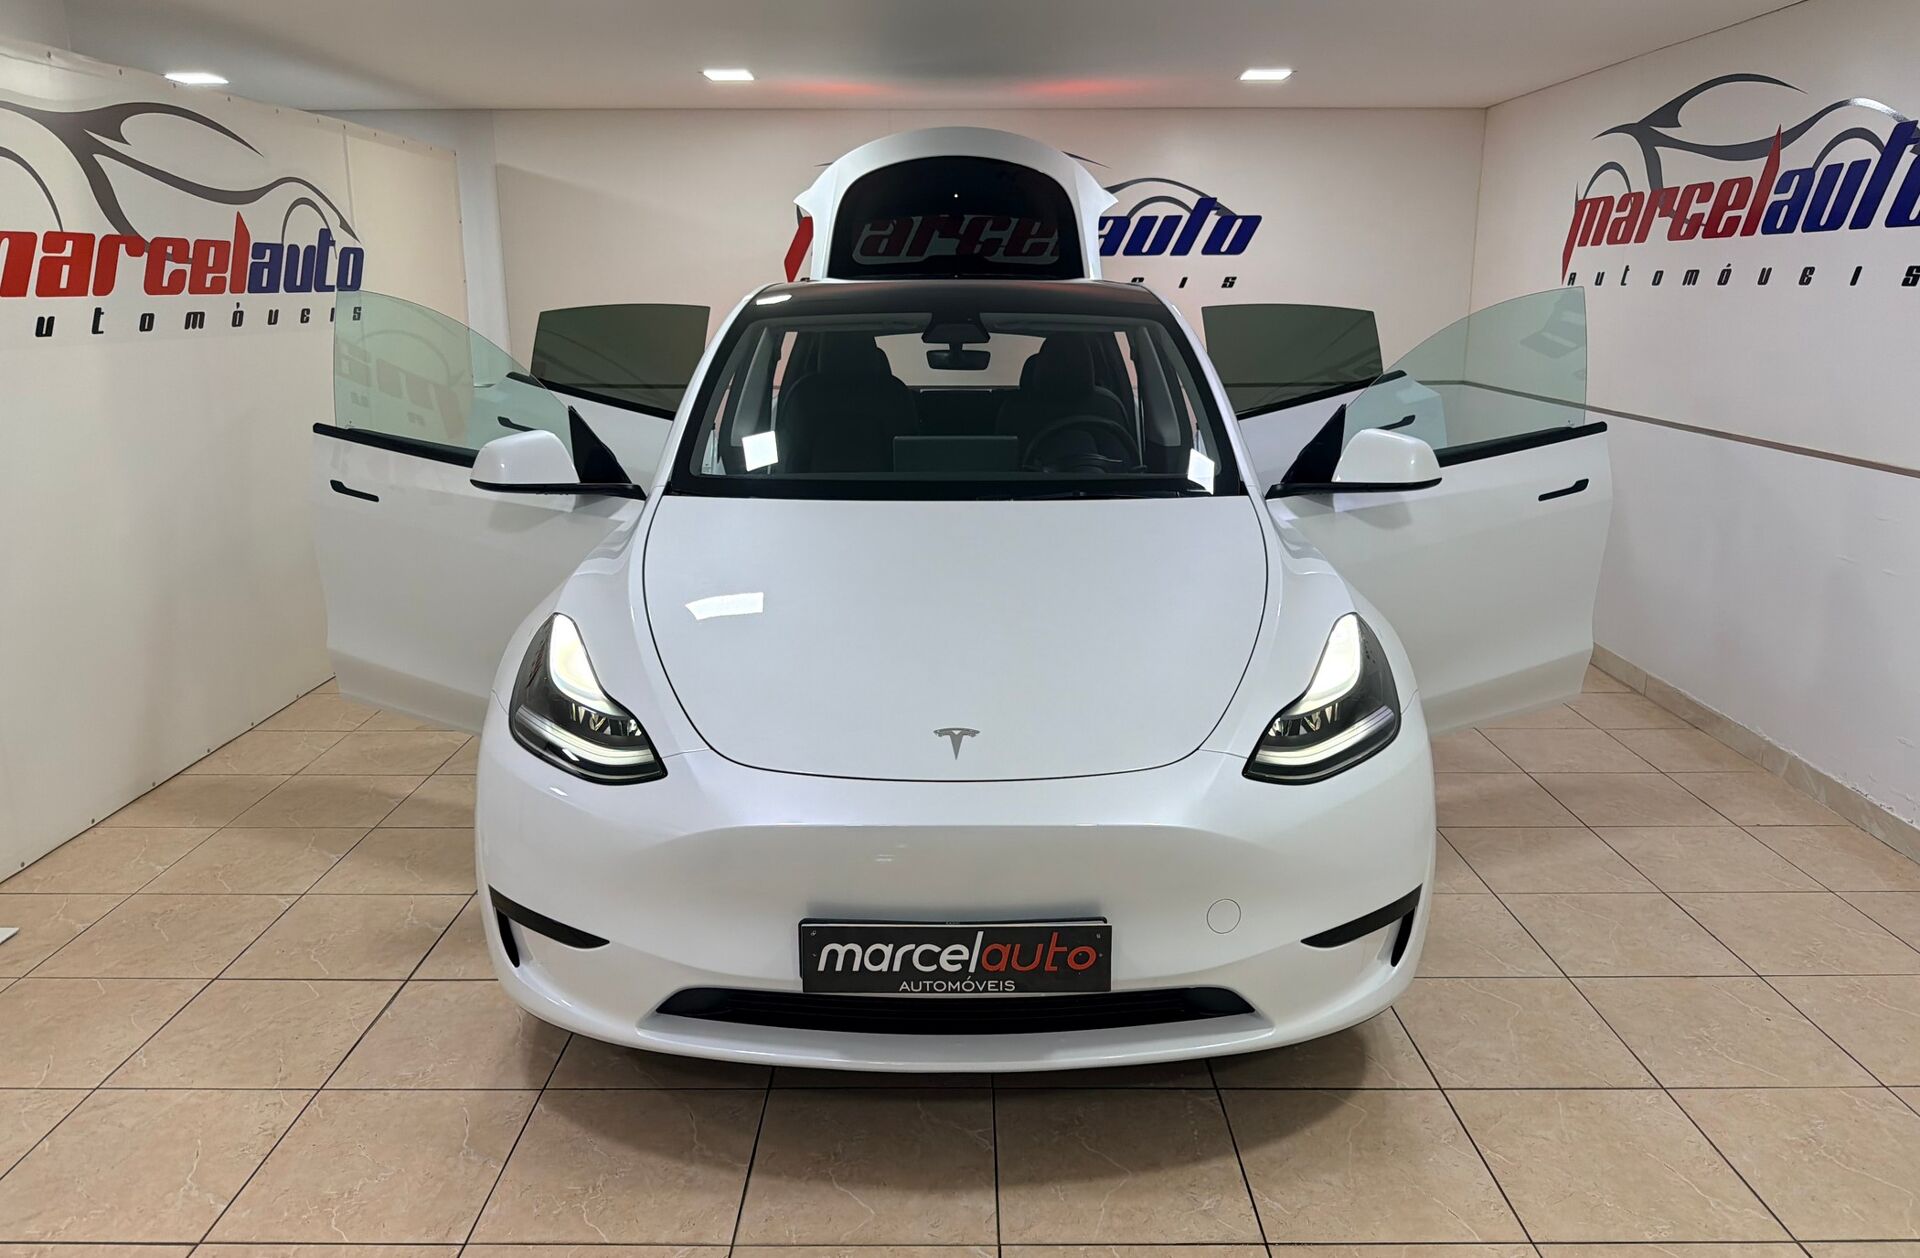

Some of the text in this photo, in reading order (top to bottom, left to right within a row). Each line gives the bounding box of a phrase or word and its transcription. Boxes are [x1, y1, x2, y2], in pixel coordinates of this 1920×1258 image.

[35, 302, 361, 338] utomóveis
[817, 930, 1097, 973] marcelauto
[899, 977, 1015, 992] AUTOMÓVEIS
